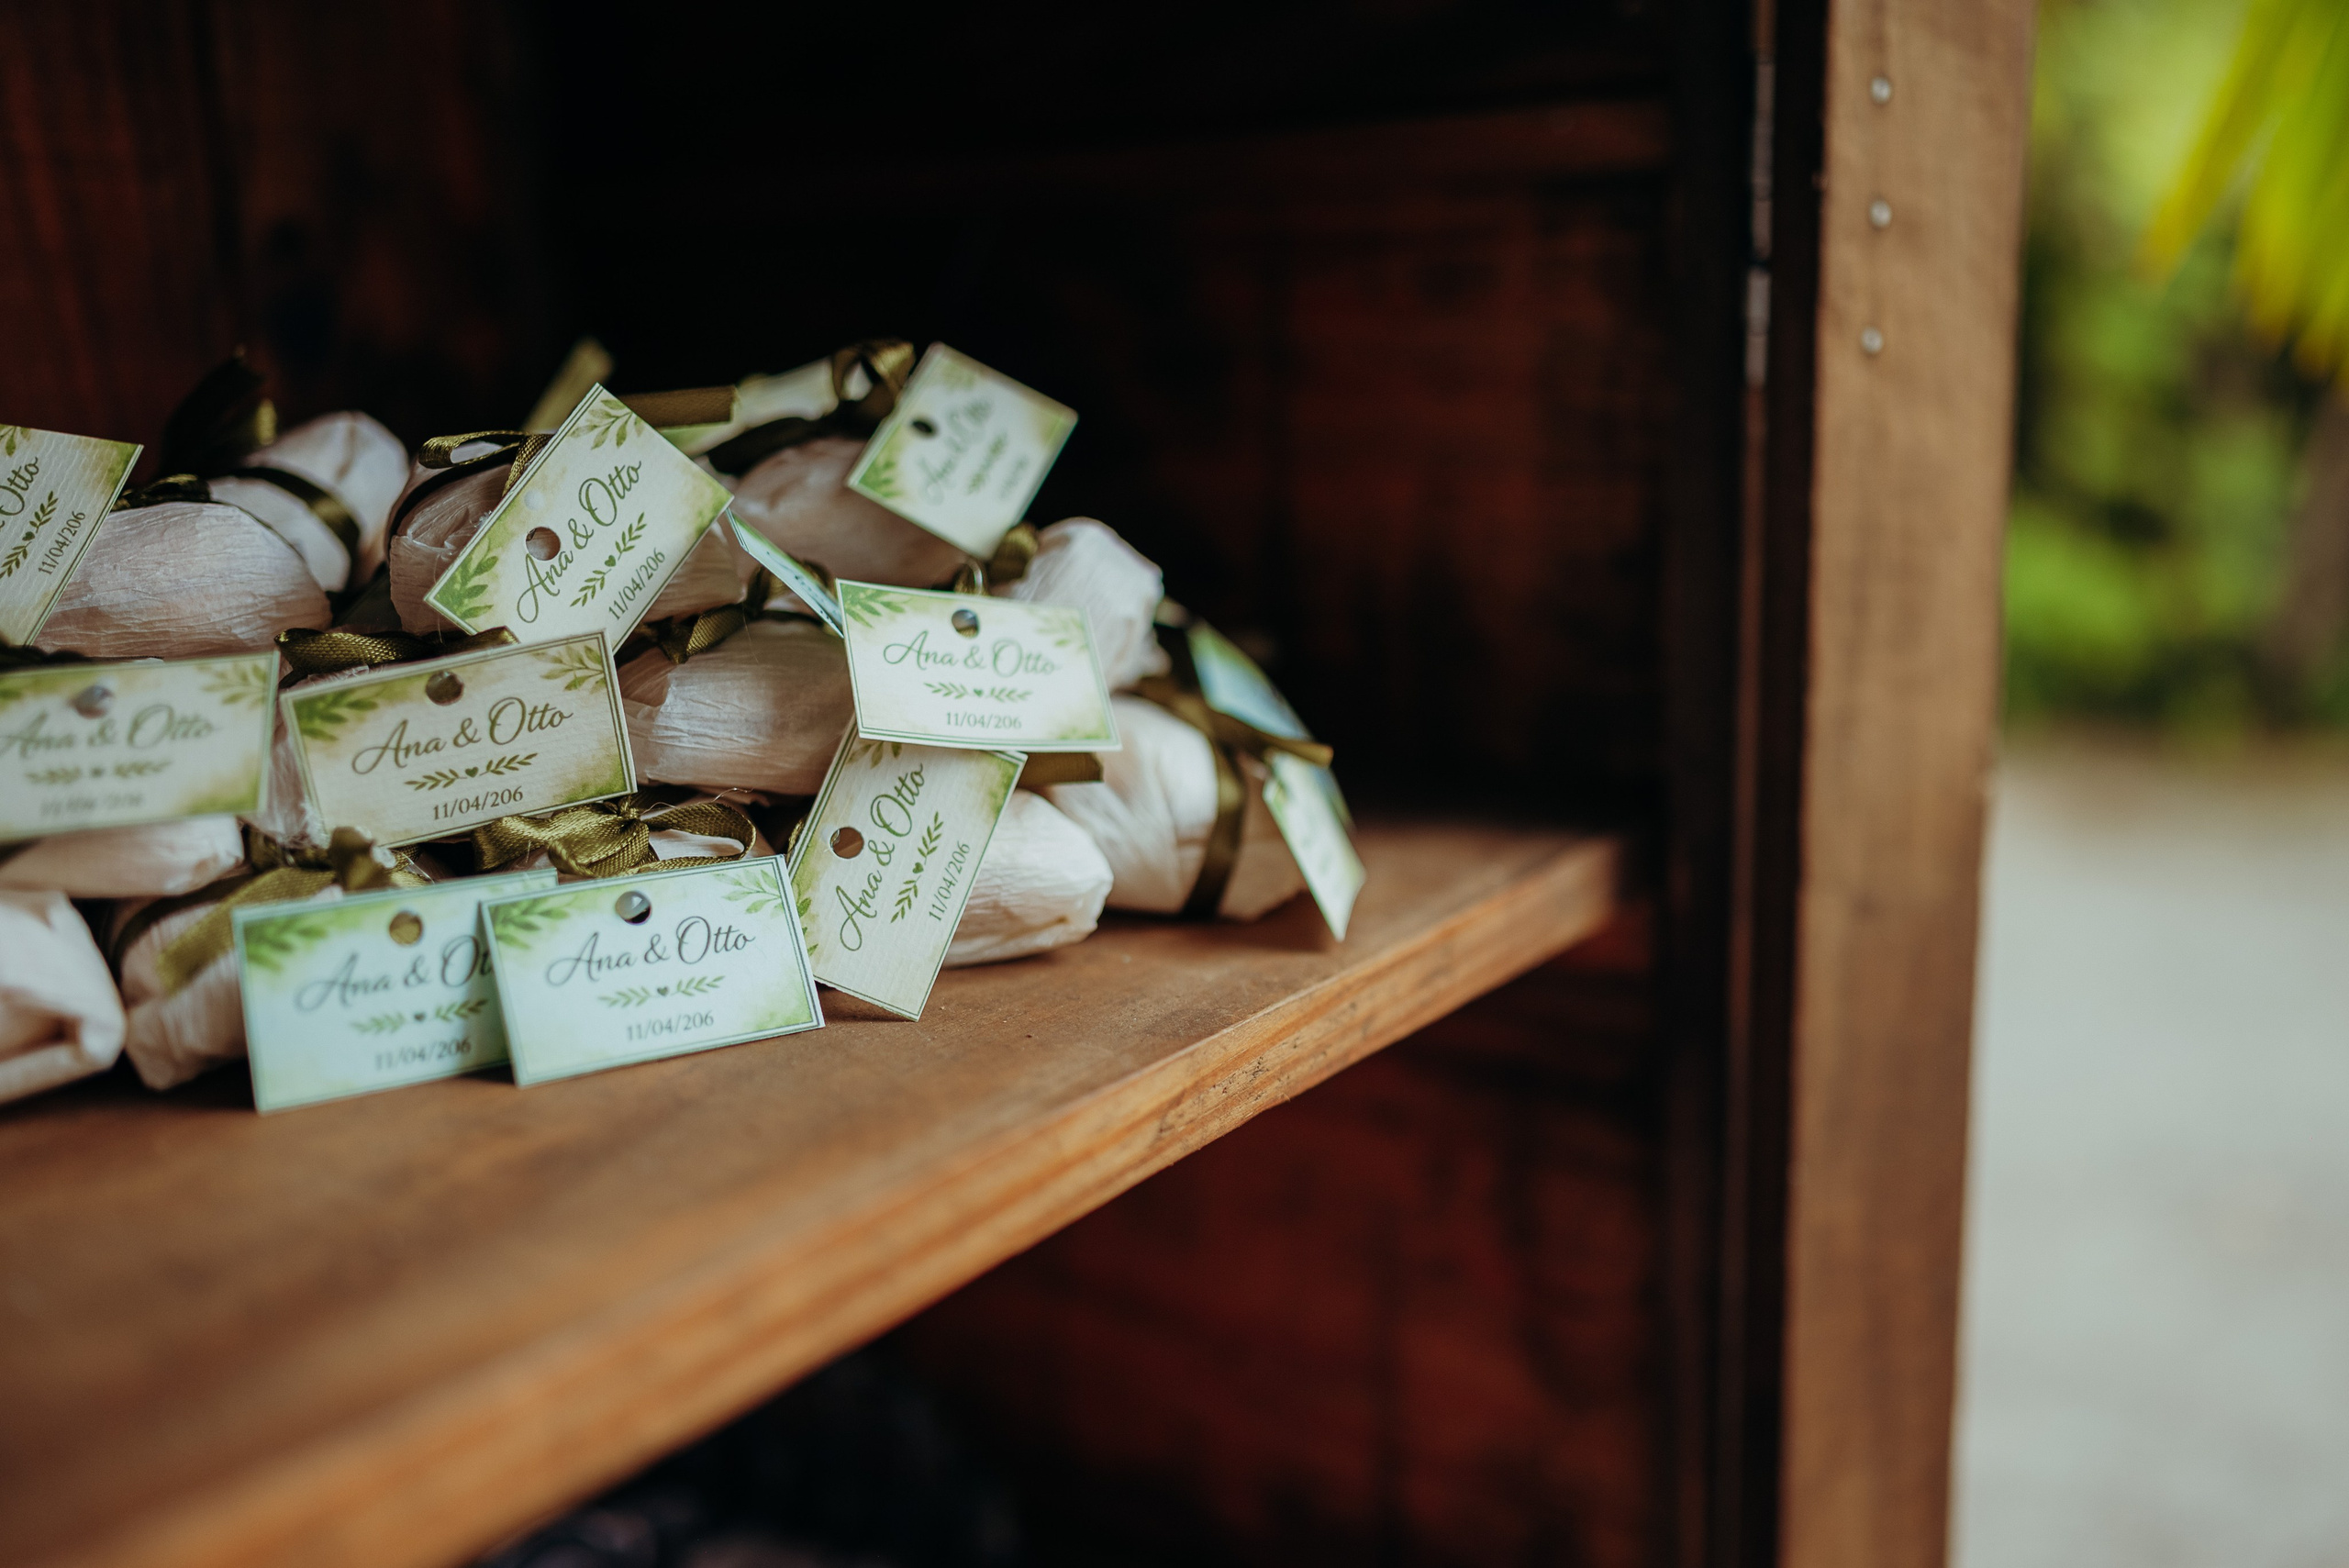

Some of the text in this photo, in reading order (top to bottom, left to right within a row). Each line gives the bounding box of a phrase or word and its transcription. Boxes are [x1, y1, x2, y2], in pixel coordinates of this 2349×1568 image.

[39, 511, 86, 574] 11/04/206
[517, 461, 642, 624] Ana & Otto
[608, 549, 666, 620] 11/04/206
[883, 630, 1062, 678] Ana & Otto
[351, 696, 573, 775] Ana & Otto
[946, 712, 1022, 730] 11/04/206
[432, 785, 524, 821] 11/04/206
[836, 763, 926, 951] Ana & Otto
[929, 840, 971, 922] 11/04/206
[293, 934, 493, 1013] Ana & Ot
[546, 916, 756, 987] Ana & Otto
[626, 1011, 715, 1041] 11/04/206
